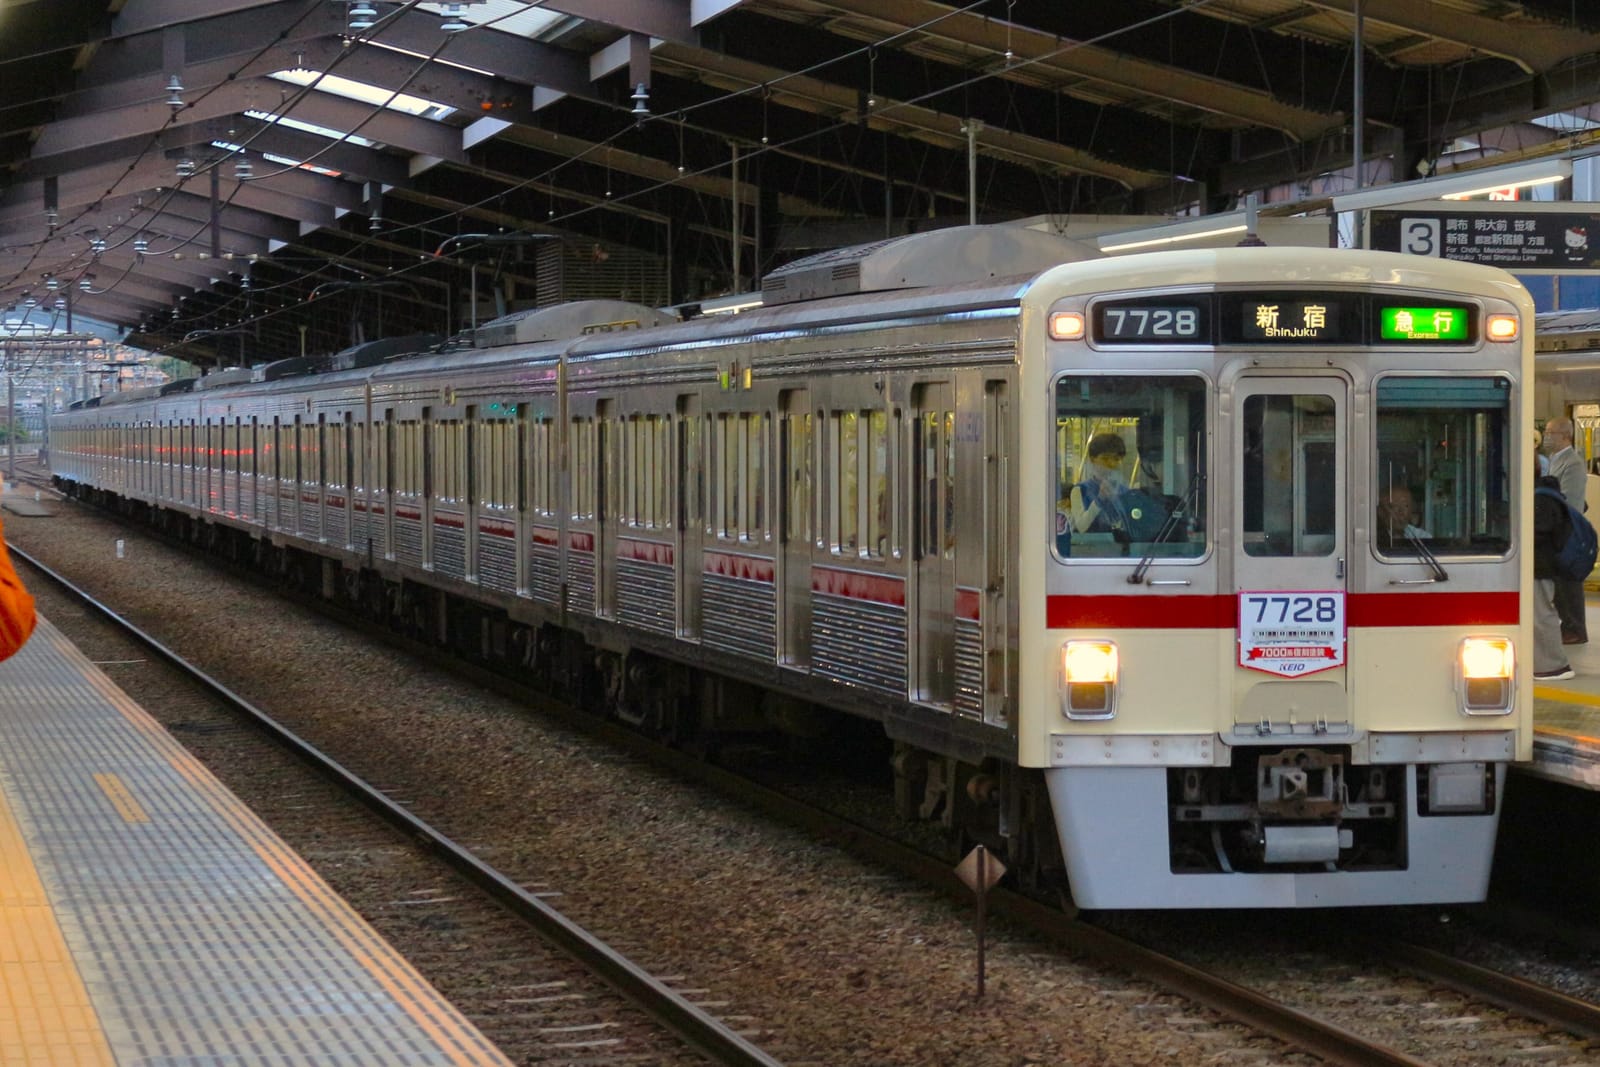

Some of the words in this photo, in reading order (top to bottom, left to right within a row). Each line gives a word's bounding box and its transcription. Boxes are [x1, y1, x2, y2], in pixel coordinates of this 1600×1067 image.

[1474, 219, 1507, 232] 明大前
[1408, 223, 1433, 256] 3
[1446, 233, 1469, 245] 新宿
[1106, 310, 1196, 336] 7728
[1256, 304, 1326, 328] 新宿
[1394, 310, 1453, 333] 急行
[1248, 597, 1336, 623] 7728
[1279, 663, 1305, 672] KEIO
